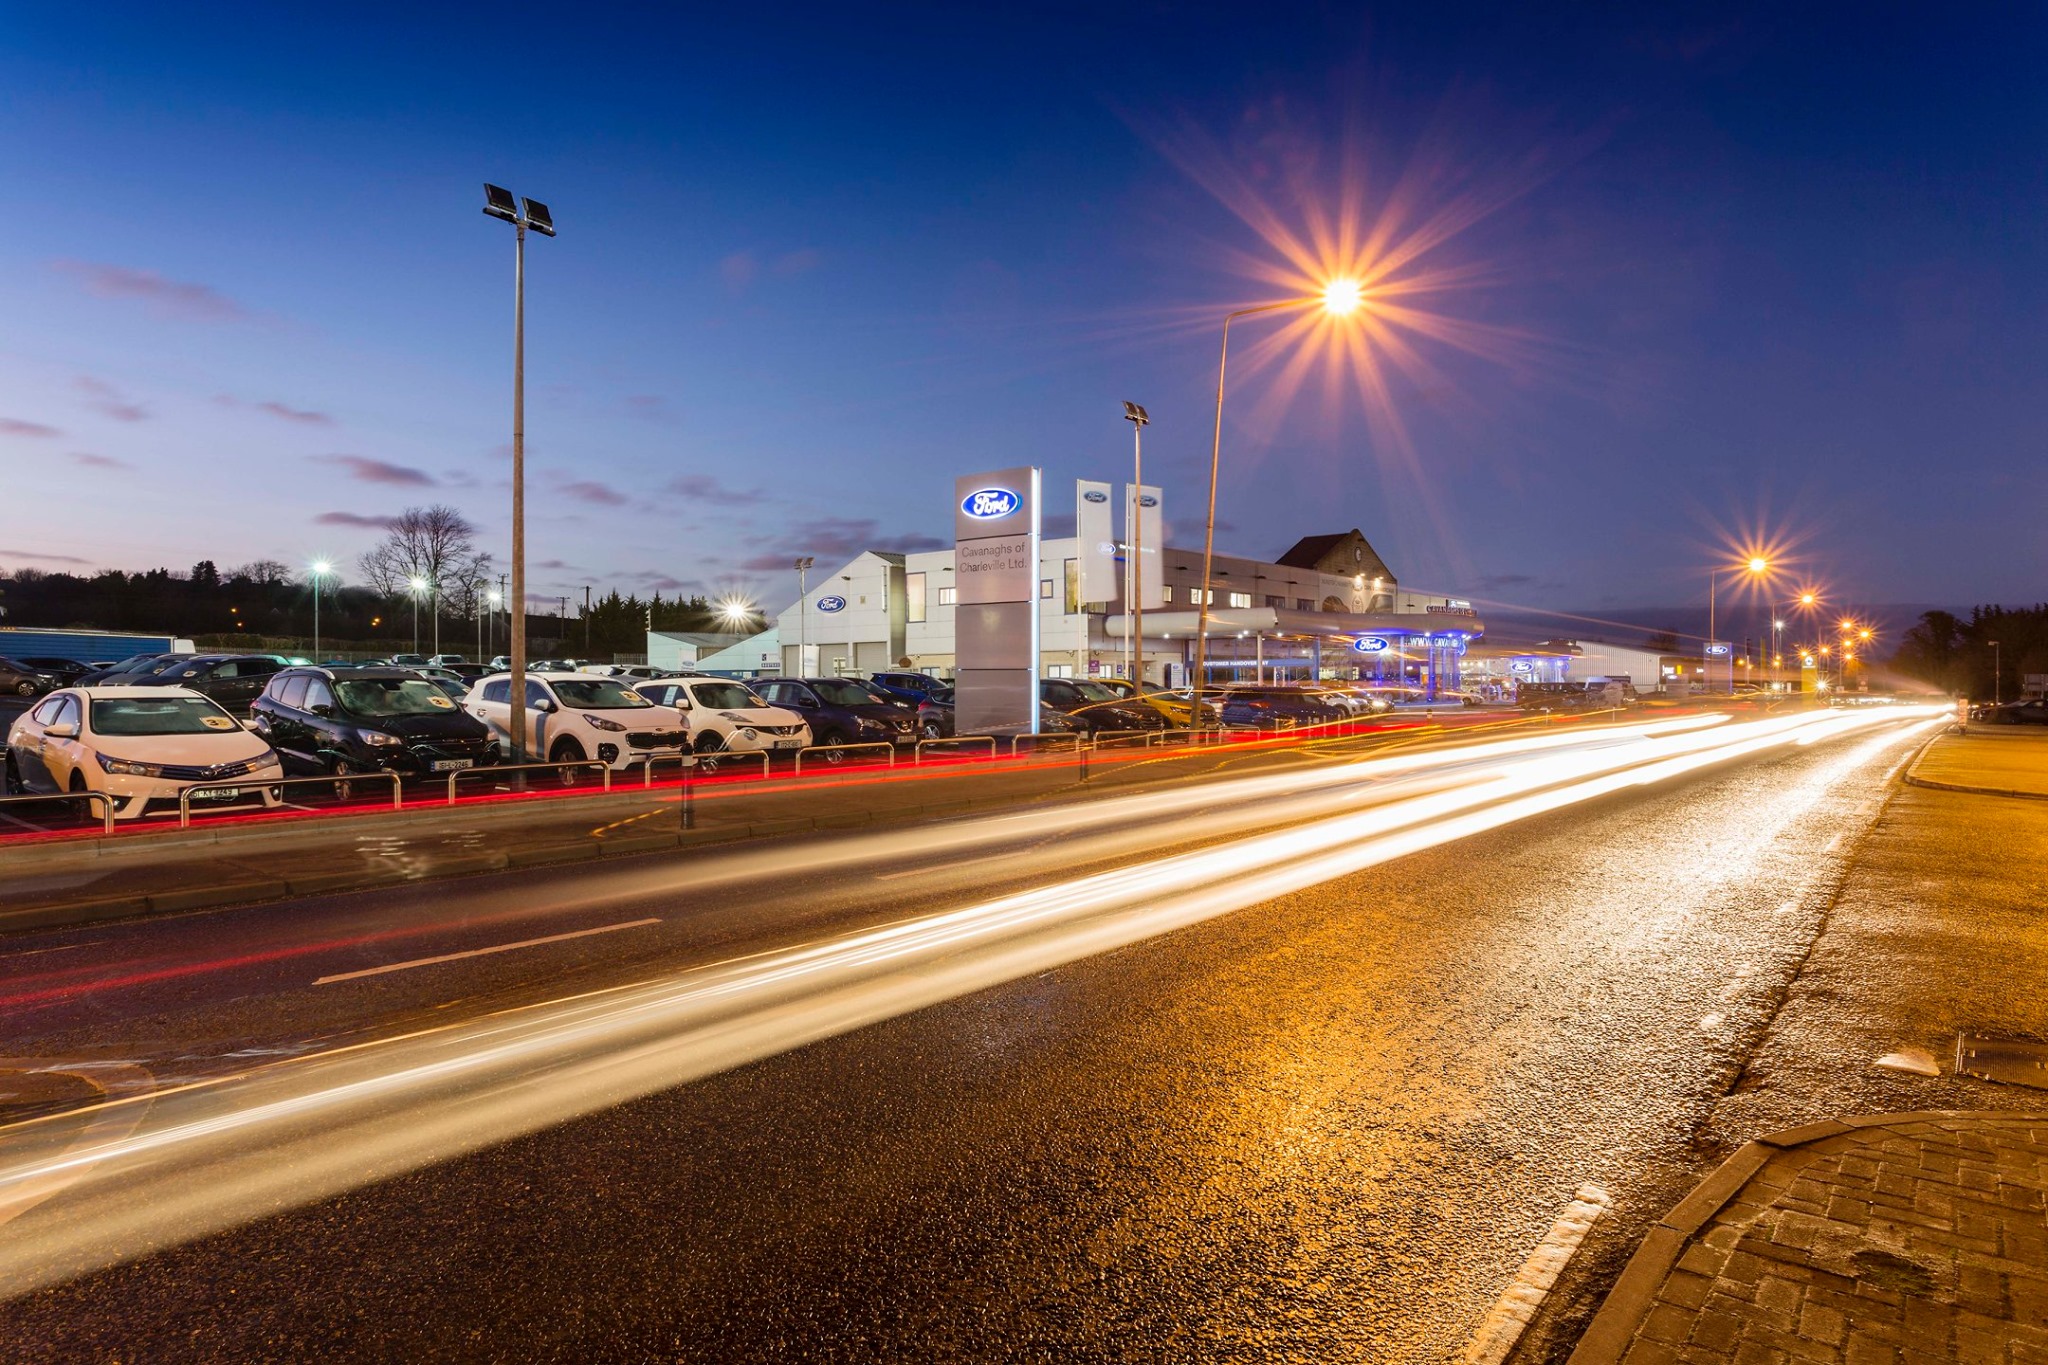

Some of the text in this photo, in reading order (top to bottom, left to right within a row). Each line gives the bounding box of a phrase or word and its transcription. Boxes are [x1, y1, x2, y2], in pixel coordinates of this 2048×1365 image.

[974, 492, 1010, 515] Ford
[961, 542, 1025, 558] Cavanaghs of
[960, 558, 1027, 573] Charleville Ltd.
